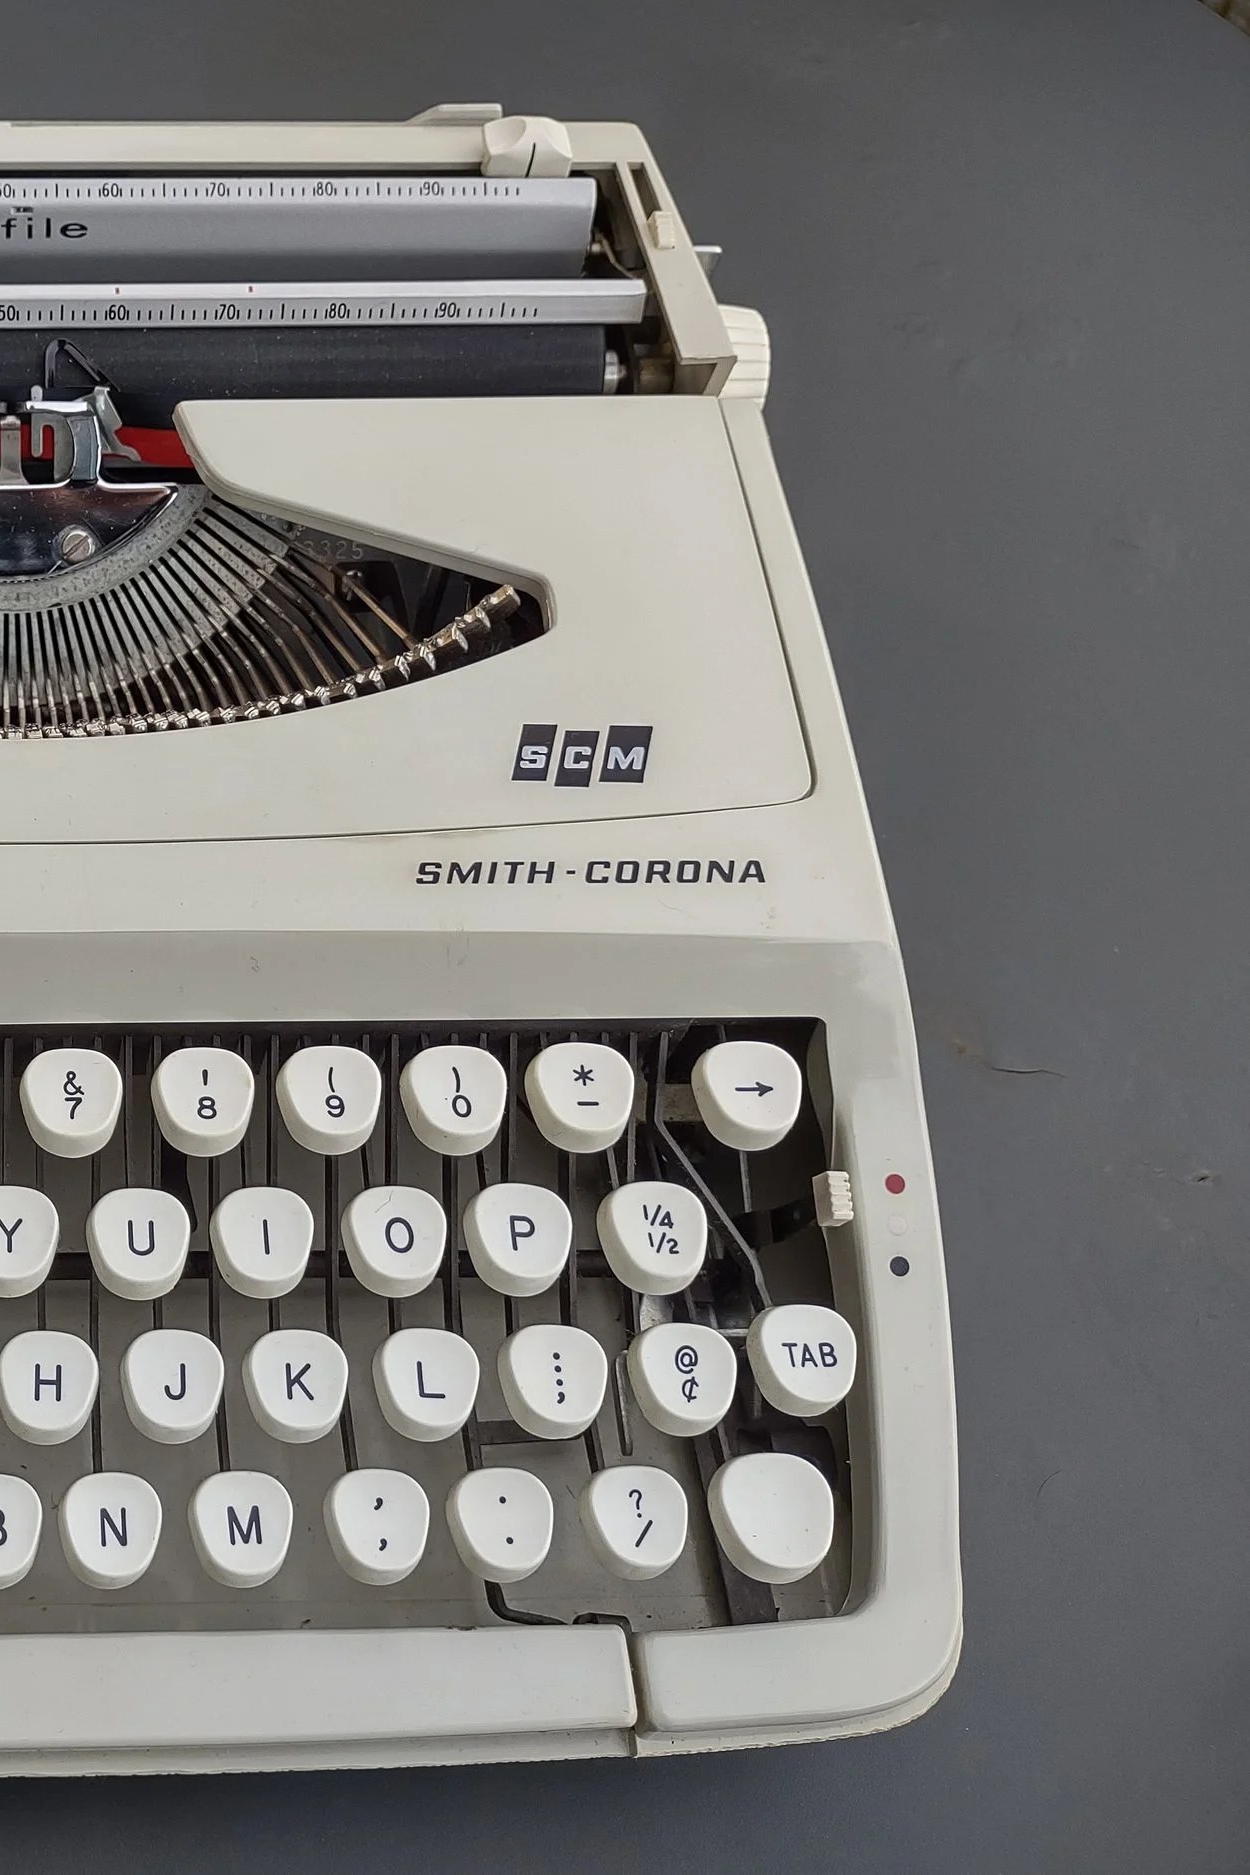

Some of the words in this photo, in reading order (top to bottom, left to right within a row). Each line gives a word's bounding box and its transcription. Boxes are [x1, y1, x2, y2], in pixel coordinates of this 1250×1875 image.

[102, 182, 119, 198] 60
[210, 181, 226, 197] 70
[316, 181, 333, 196] 80
[423, 181, 440, 196] 90
[108, 304, 126, 321] 60
[218, 303, 236, 320] 70
[329, 303, 347, 319] 80
[439, 302, 457, 318] 90
[519, 744, 646, 771] SCM
[416, 860, 765, 884] SMITH-CORONA
[63, 1070, 85, 1096] &
[64, 1096, 83, 1120] 7
[196, 1096, 218, 1120] 8
[325, 1094, 346, 1118] 9
[451, 1094, 472, 1118] 0
[127, 1219, 155, 1257] U
[262, 1218, 271, 1256] I
[384, 1216, 415, 1254] O
[509, 1215, 536, 1252] P
[674, 1344, 699, 1375] @
[781, 1342, 838, 1368] TAB
[34, 1363, 62, 1402] H
[163, 1362, 187, 1401] J
[285, 1362, 315, 1401] K
[416, 1360, 446, 1400] L
[628, 1488, 644, 1519] ?
[99, 1506, 128, 1548] N
[226, 1505, 263, 1546] M
[634, 1519, 654, 1548] /
